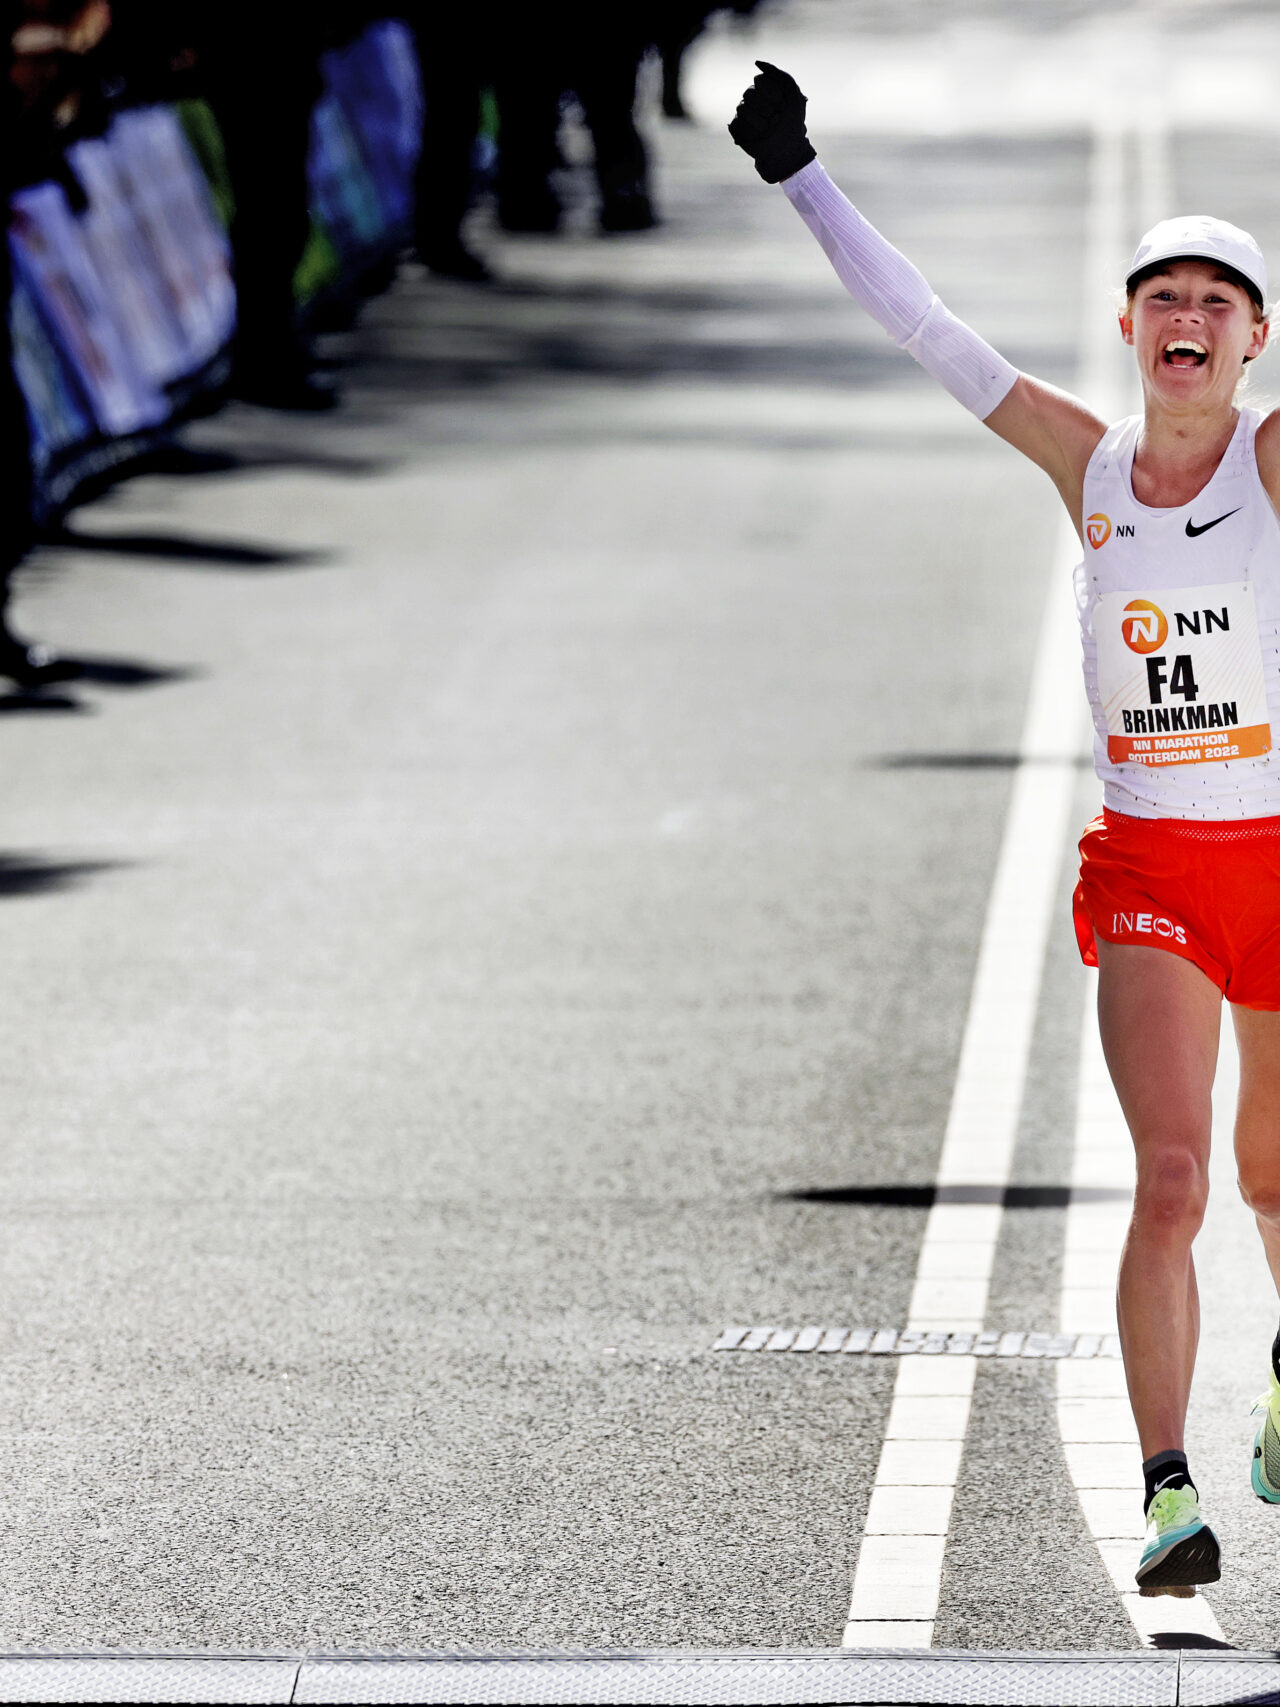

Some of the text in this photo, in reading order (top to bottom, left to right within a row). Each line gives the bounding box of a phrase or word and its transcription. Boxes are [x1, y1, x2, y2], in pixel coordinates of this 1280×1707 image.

[1116, 525, 1134, 537] NN
[1174, 607, 1230, 636] NN
[1146, 655, 1199, 704] F4
[1122, 702, 1239, 733] BRINKMAN
[1133, 733, 1229, 751] NN MARATHON
[1204, 745, 1240, 759] 2022
[1111, 912, 1187, 945] INEOS
